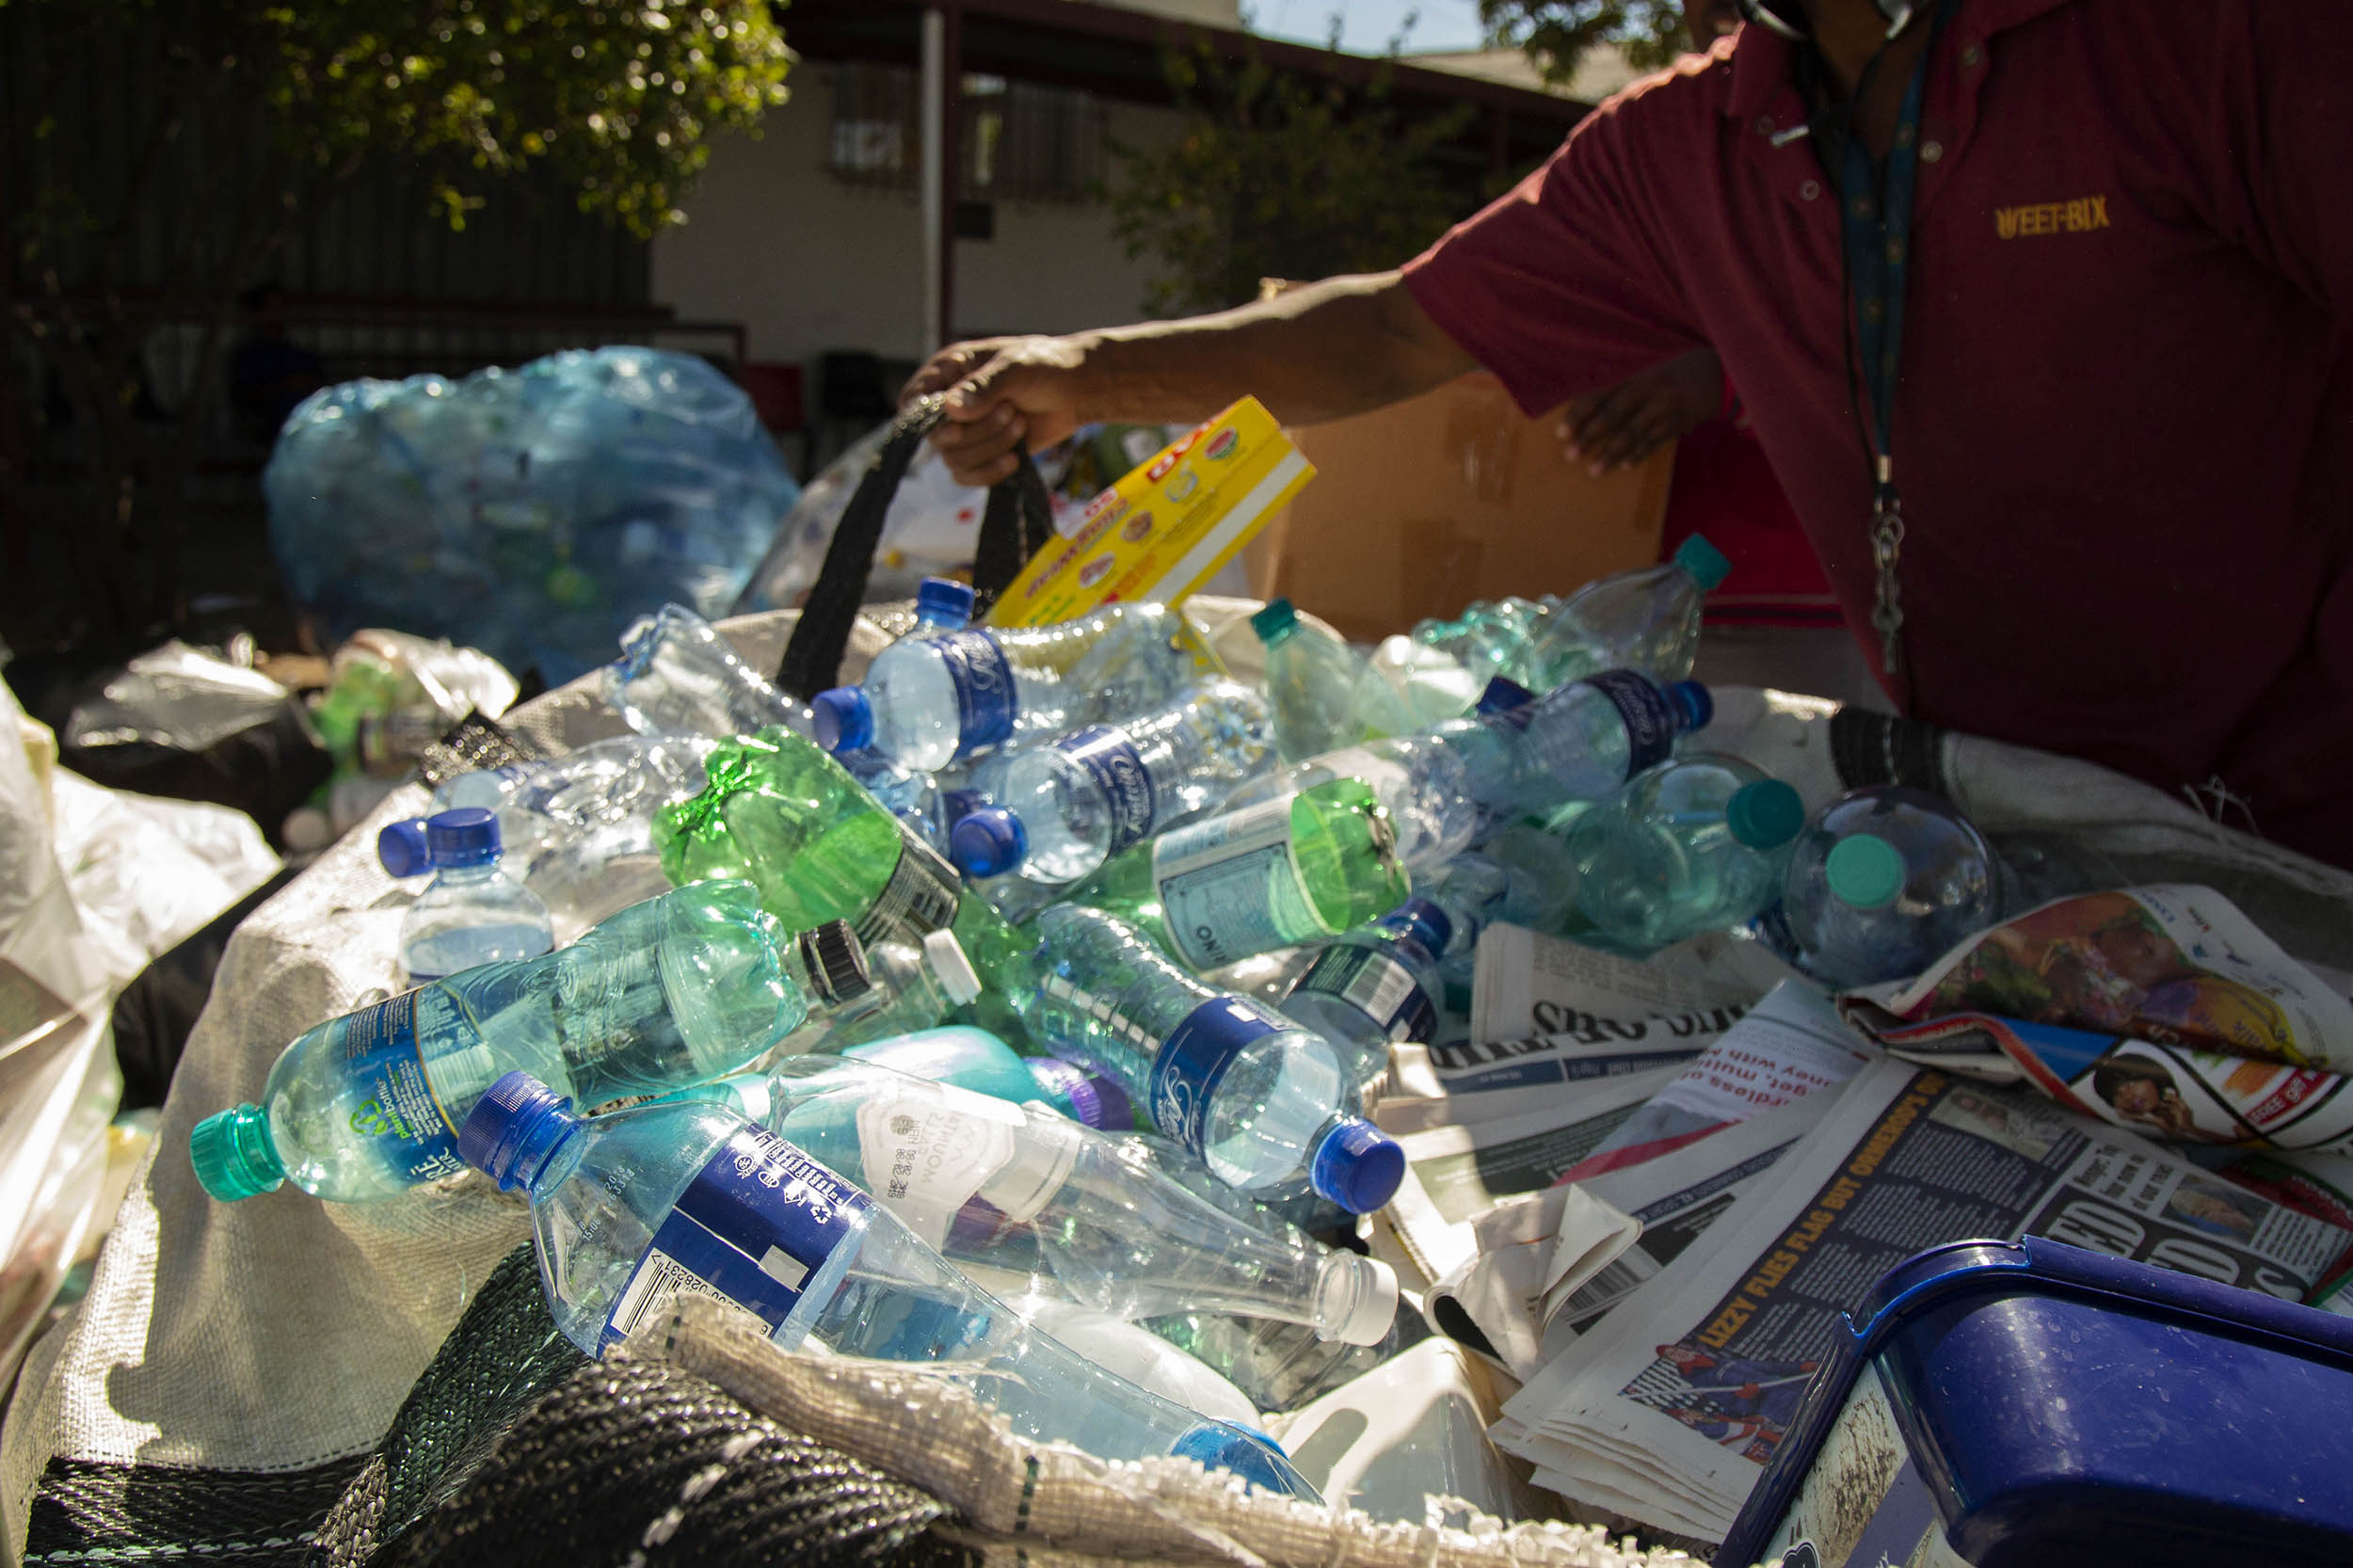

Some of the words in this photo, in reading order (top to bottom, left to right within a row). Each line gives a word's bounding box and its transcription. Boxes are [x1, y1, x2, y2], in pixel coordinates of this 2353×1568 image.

[1994, 195, 2110, 240] WEET-BIX
[1699, 1296, 1757, 1349] LIZZY
[1745, 1249, 1800, 1298] FLIES
[1785, 1209, 1833, 1251] FLAG
[1820, 1177, 1864, 1211] BUT
